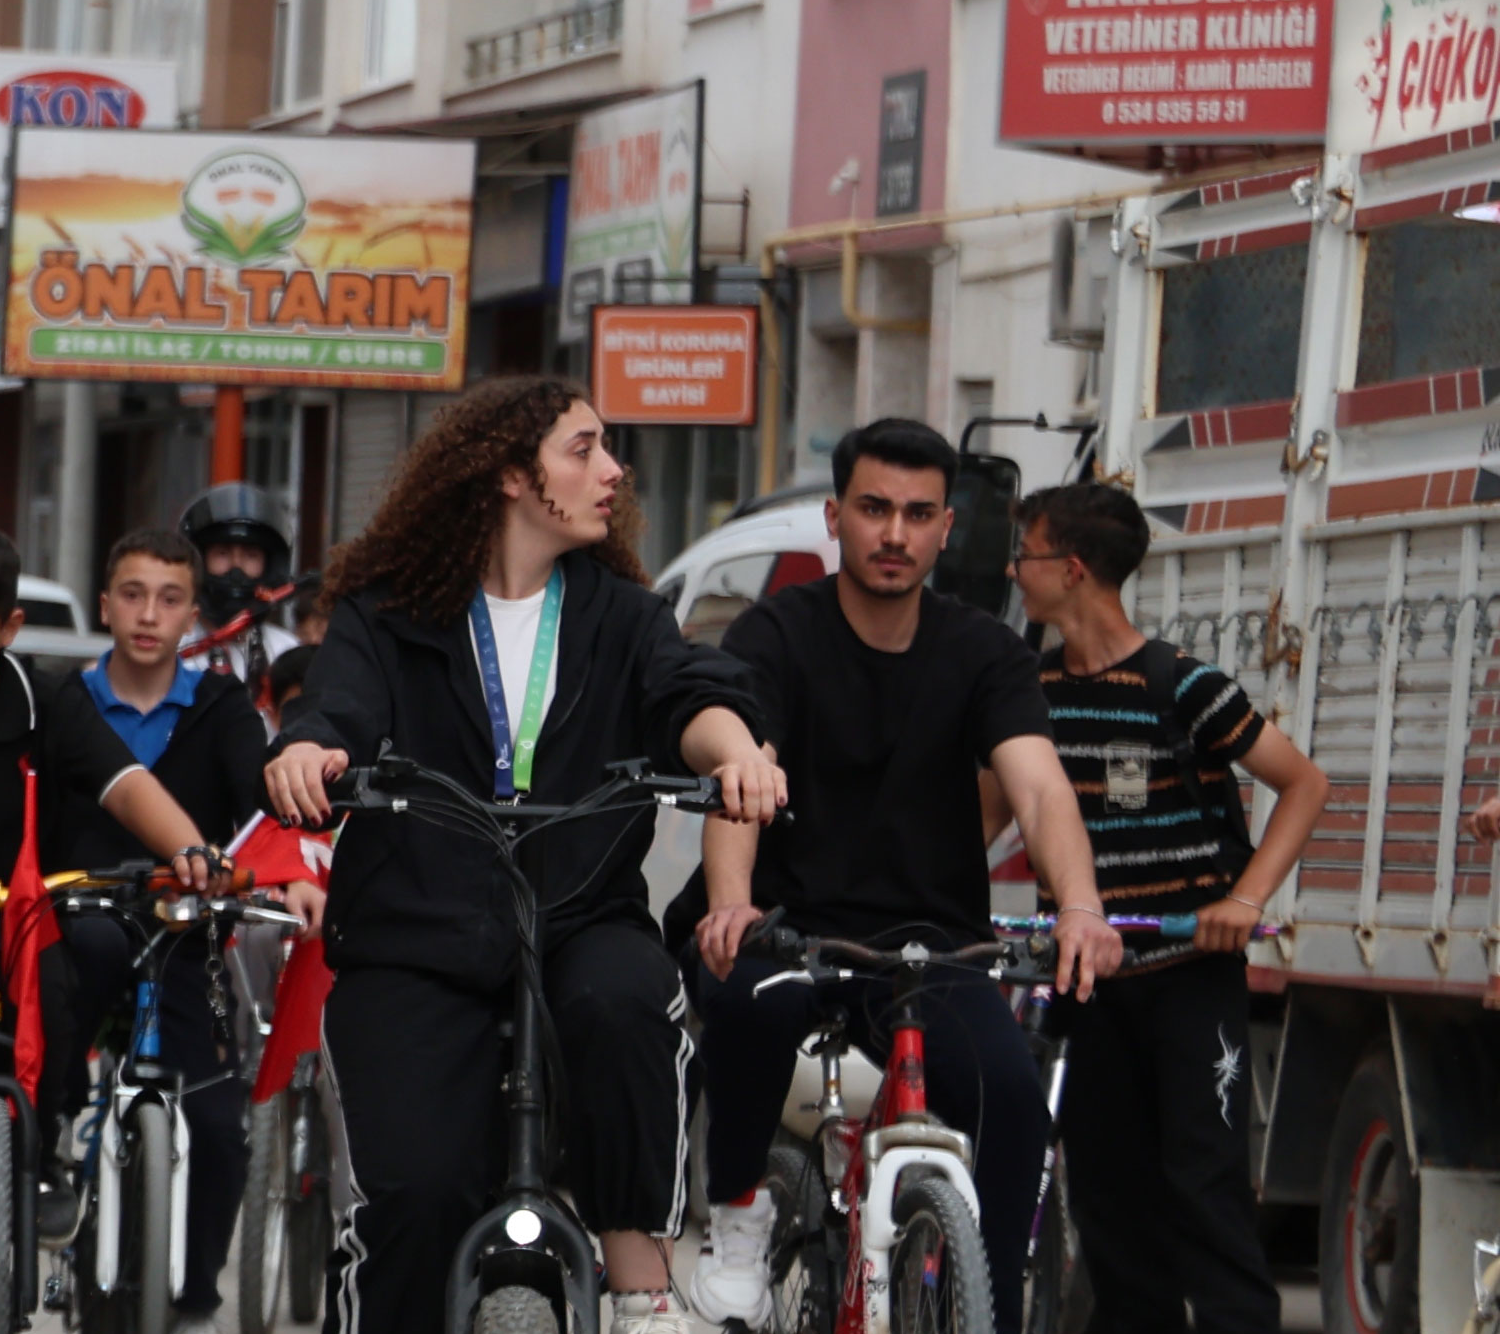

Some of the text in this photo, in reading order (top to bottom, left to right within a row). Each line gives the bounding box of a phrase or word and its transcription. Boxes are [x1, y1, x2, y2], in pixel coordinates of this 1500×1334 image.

[1044, 3, 1317, 56] VETERİNER KLİNİĞİ
[1042, 62, 1120, 94] VETERİNER
[1122, 58, 1176, 91] HEKİMİ
[1185, 58, 1233, 89] KAMİL
[1235, 55, 1313, 89] DAĞDELEN
[8, 82, 130, 127] KON
[1102, 98, 1246, 124] 0 534 935 59 31
[30, 249, 451, 329] ÖNAL TARIM
[54, 331, 129, 357] ZİRAİ
[132, 333, 193, 360] İLAÇ
[219, 343, 312, 363] TOHUM
[336, 342, 426, 367] GÜBRE
[603, 330, 746, 353] BİTKİ KORUMA
[624, 355, 726, 380] ÜRÜNLERİ
[640, 382, 708, 407] BAYİSİ
